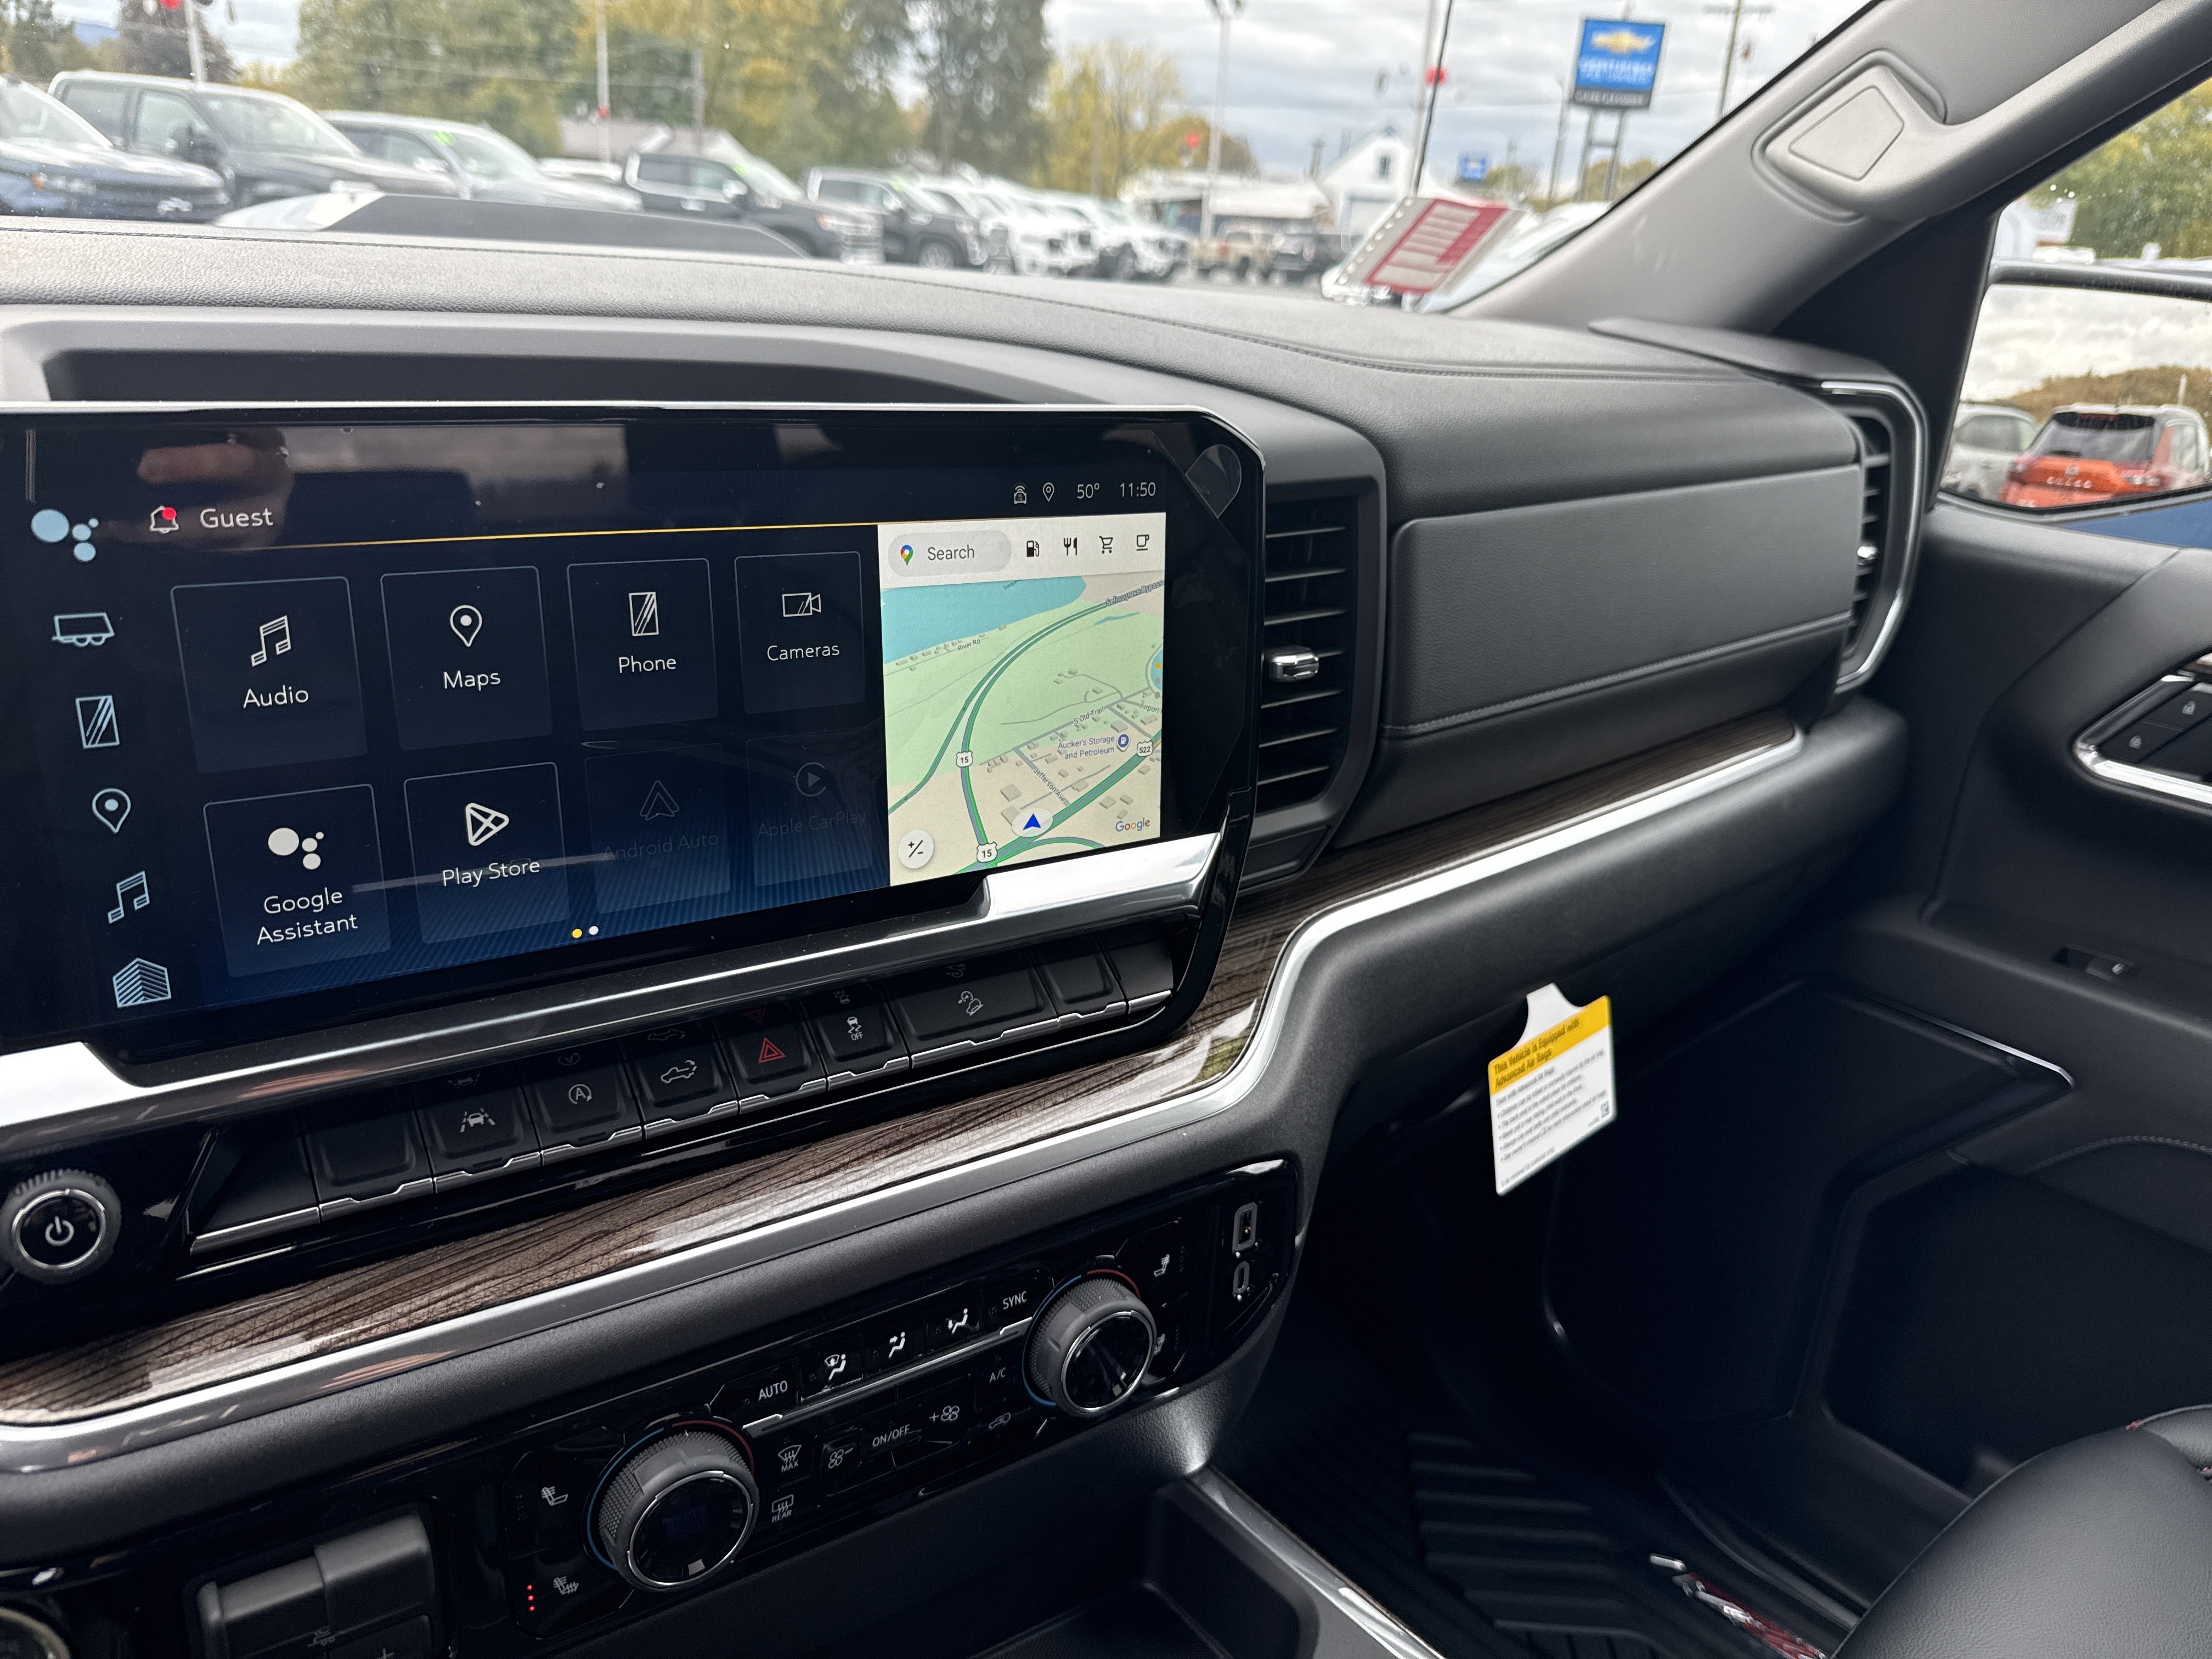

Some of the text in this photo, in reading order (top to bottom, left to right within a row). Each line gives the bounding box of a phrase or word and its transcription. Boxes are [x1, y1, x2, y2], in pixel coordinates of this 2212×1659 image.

[1120, 482, 1156, 498] 11:50
[199, 506, 274, 529] Guest
[927, 544, 975, 561] Search
[1106, 580, 1163, 606] Selinsgrove Bypass
[767, 644, 840, 661] Cameras
[957, 642, 972, 651] River
[618, 655, 677, 674] Phone
[443, 670, 501, 691] Maps
[243, 685, 309, 708] Audio
[1079, 713, 1090, 723] Old
[1091, 706, 1104, 717] Trail
[1139, 703, 1160, 713] Airport
[1058, 736, 1115, 749] Aucker's Storage
[1064, 747, 1114, 760] and Petroleum
[1033, 768, 1065, 802] Jefferson Ave
[757, 811, 867, 839] Apple CarPlay
[1115, 817, 1150, 832] Google
[602, 833, 719, 862] Android Auto
[981, 849, 992, 858] 15
[442, 859, 541, 888] Play Store
[263, 888, 343, 913] Google
[257, 913, 358, 945] Assistant
[851, 1031, 863, 1041] OFF
[1003, 1291, 1027, 1310] SYNC
[989, 1367, 1006, 1383] A/C
[758, 1380, 788, 1401] AUTO
[872, 1424, 910, 1447] ON/OFF
[781, 1460, 799, 1472] MAX
[771, 1509, 792, 1523] REAR
